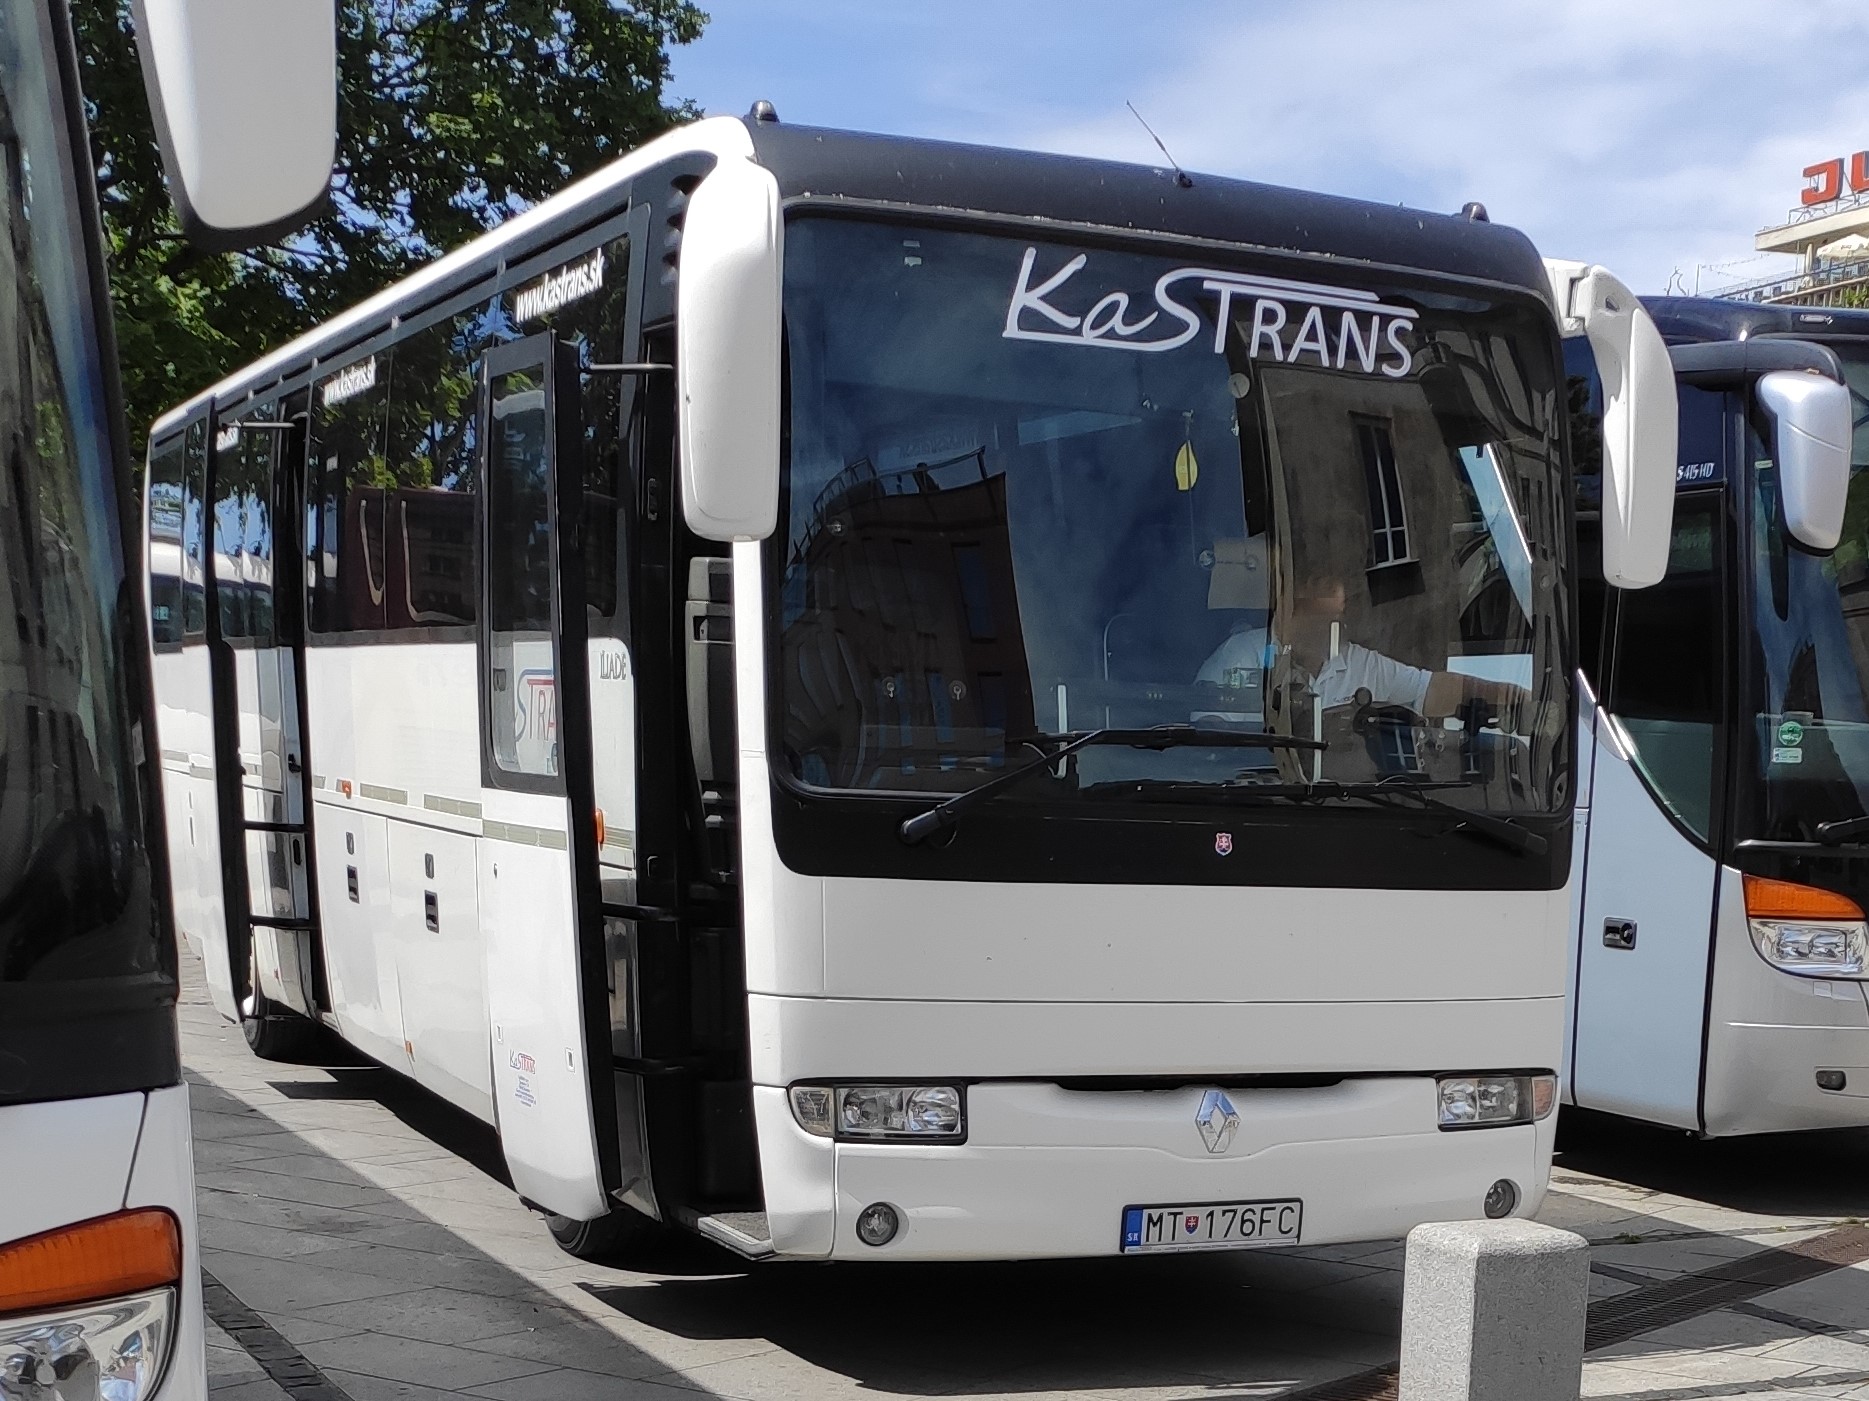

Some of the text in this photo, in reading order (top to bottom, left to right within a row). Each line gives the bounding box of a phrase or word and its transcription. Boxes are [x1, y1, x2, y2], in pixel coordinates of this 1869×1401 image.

[516, 247, 605, 323] www.kastrans.sk
[1145, 1211, 1183, 1243] MT
[1205, 1205, 1296, 1239] 176FC
